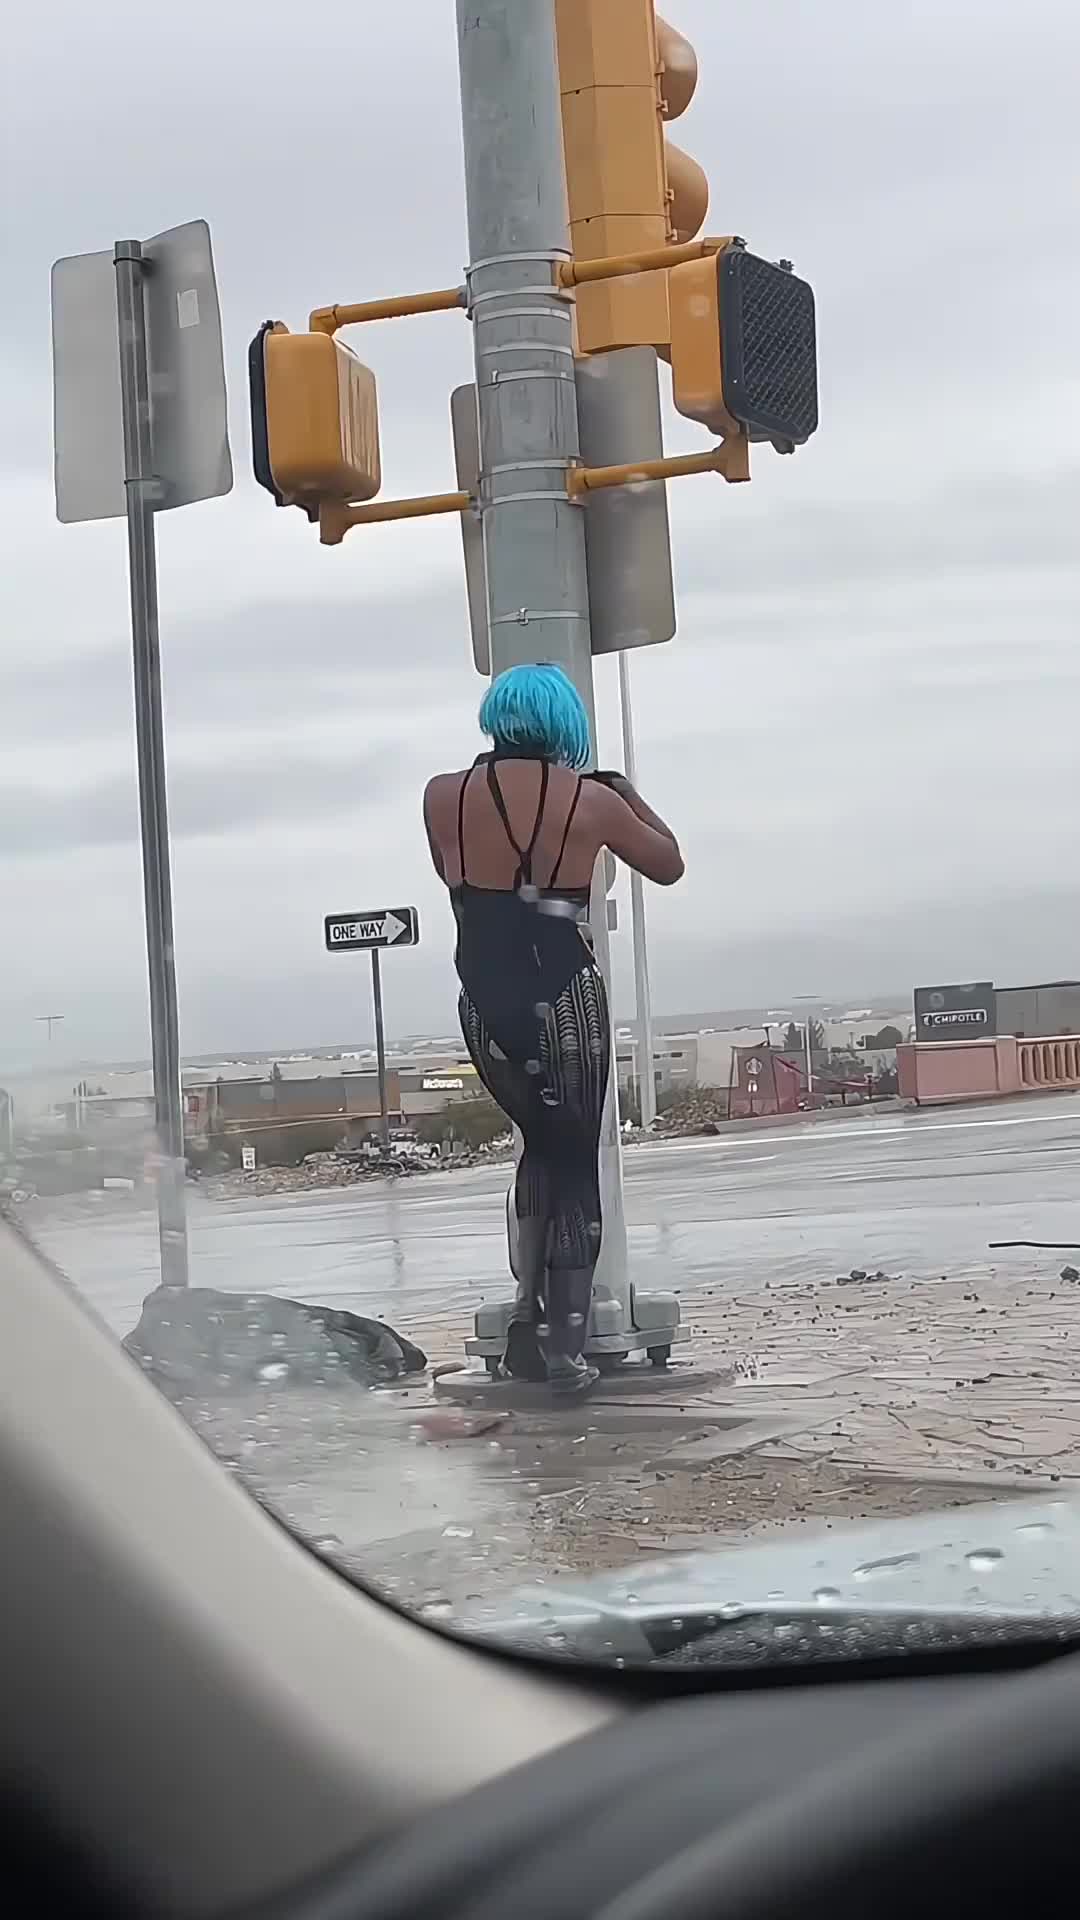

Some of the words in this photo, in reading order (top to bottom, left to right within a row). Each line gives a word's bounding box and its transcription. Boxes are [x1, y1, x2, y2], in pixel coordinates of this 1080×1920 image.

[333, 924, 357, 940] ONE
[360, 921, 384, 938] WAY
[934, 1012, 982, 1024] CHIPOTLE
